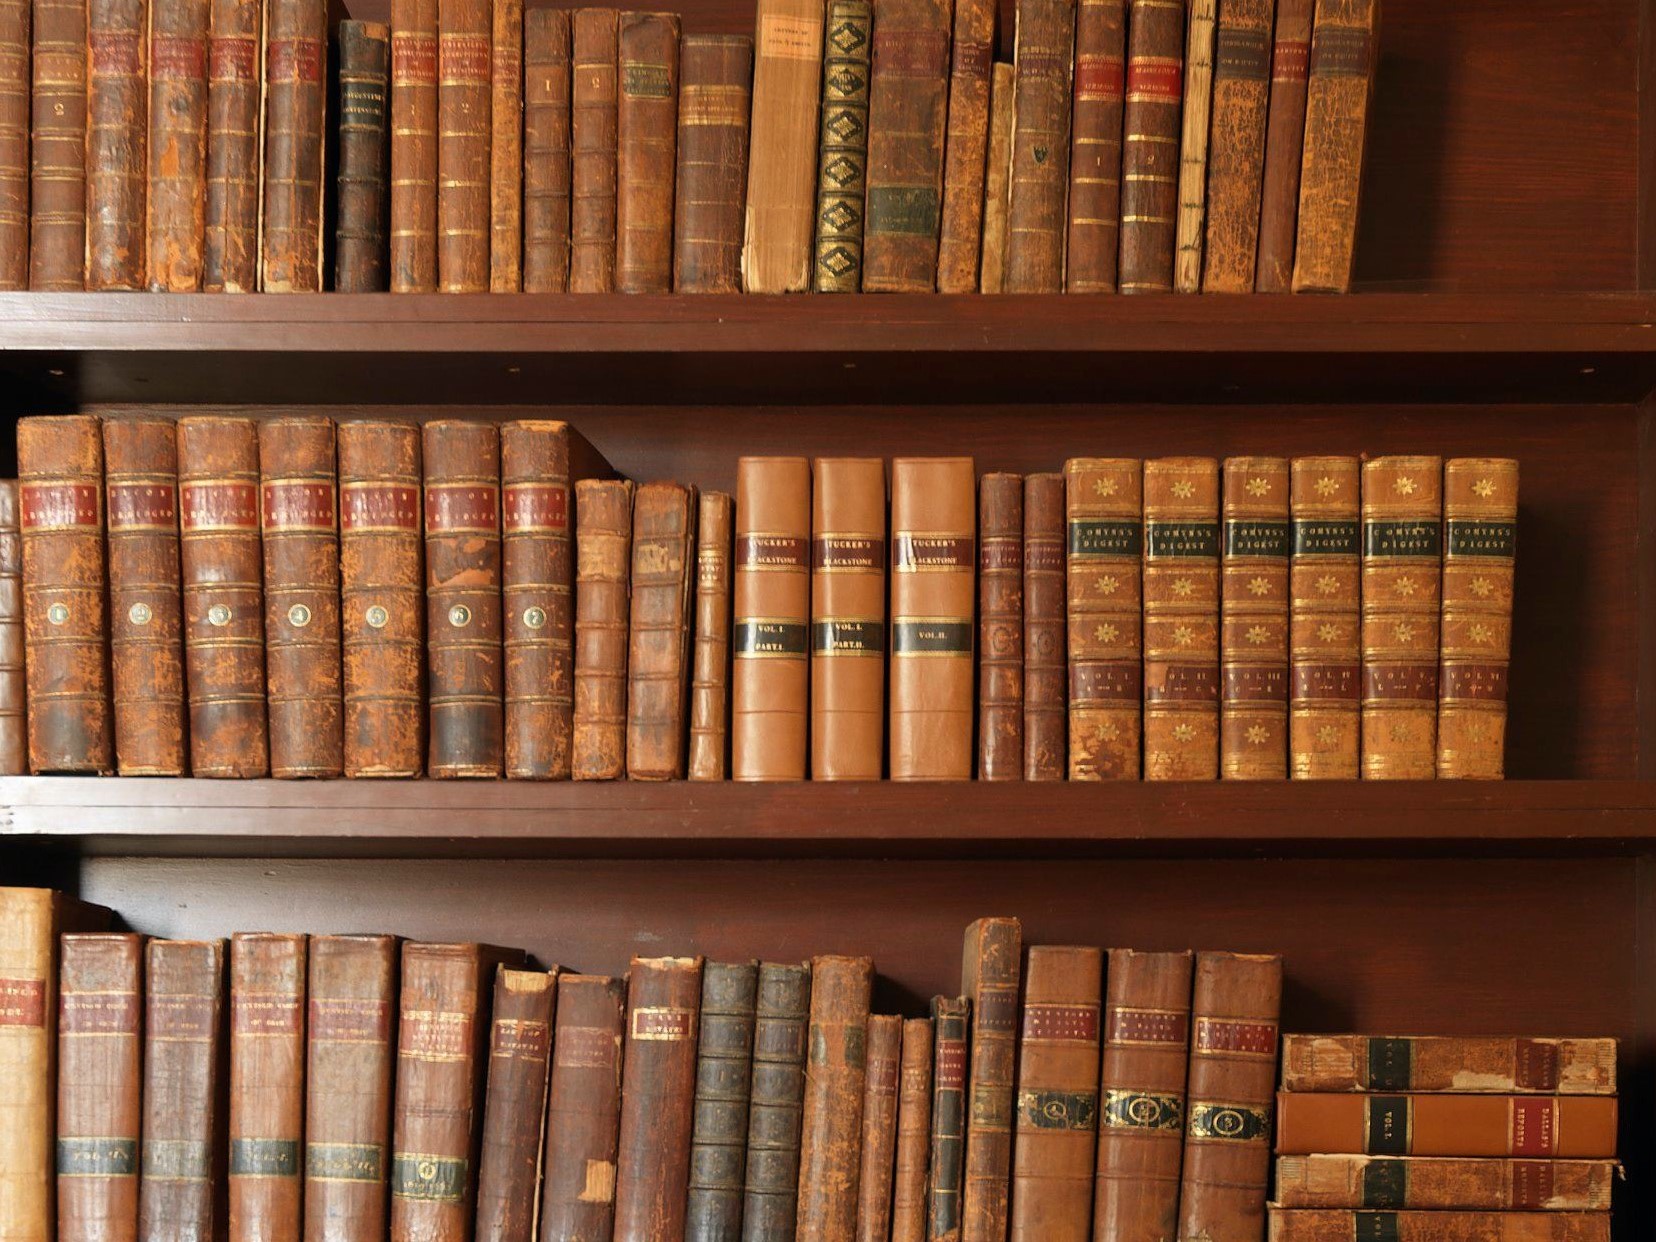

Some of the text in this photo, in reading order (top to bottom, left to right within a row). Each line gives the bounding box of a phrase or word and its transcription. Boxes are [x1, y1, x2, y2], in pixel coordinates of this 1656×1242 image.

[829, 540, 871, 549] TUCKER'S
[912, 539, 956, 549] TUCKER'S
[1083, 539, 1128, 549] DIGEST
[1160, 541, 1205, 550] DIGEST
[1238, 540, 1280, 549] DIGEST
[1306, 538, 1350, 548] DIGEST
[1459, 540, 1506, 549] DIGEST
[1516, 1107, 1526, 1147] REPORTS
[1541, 1107, 1550, 1149] DALLAS'S
